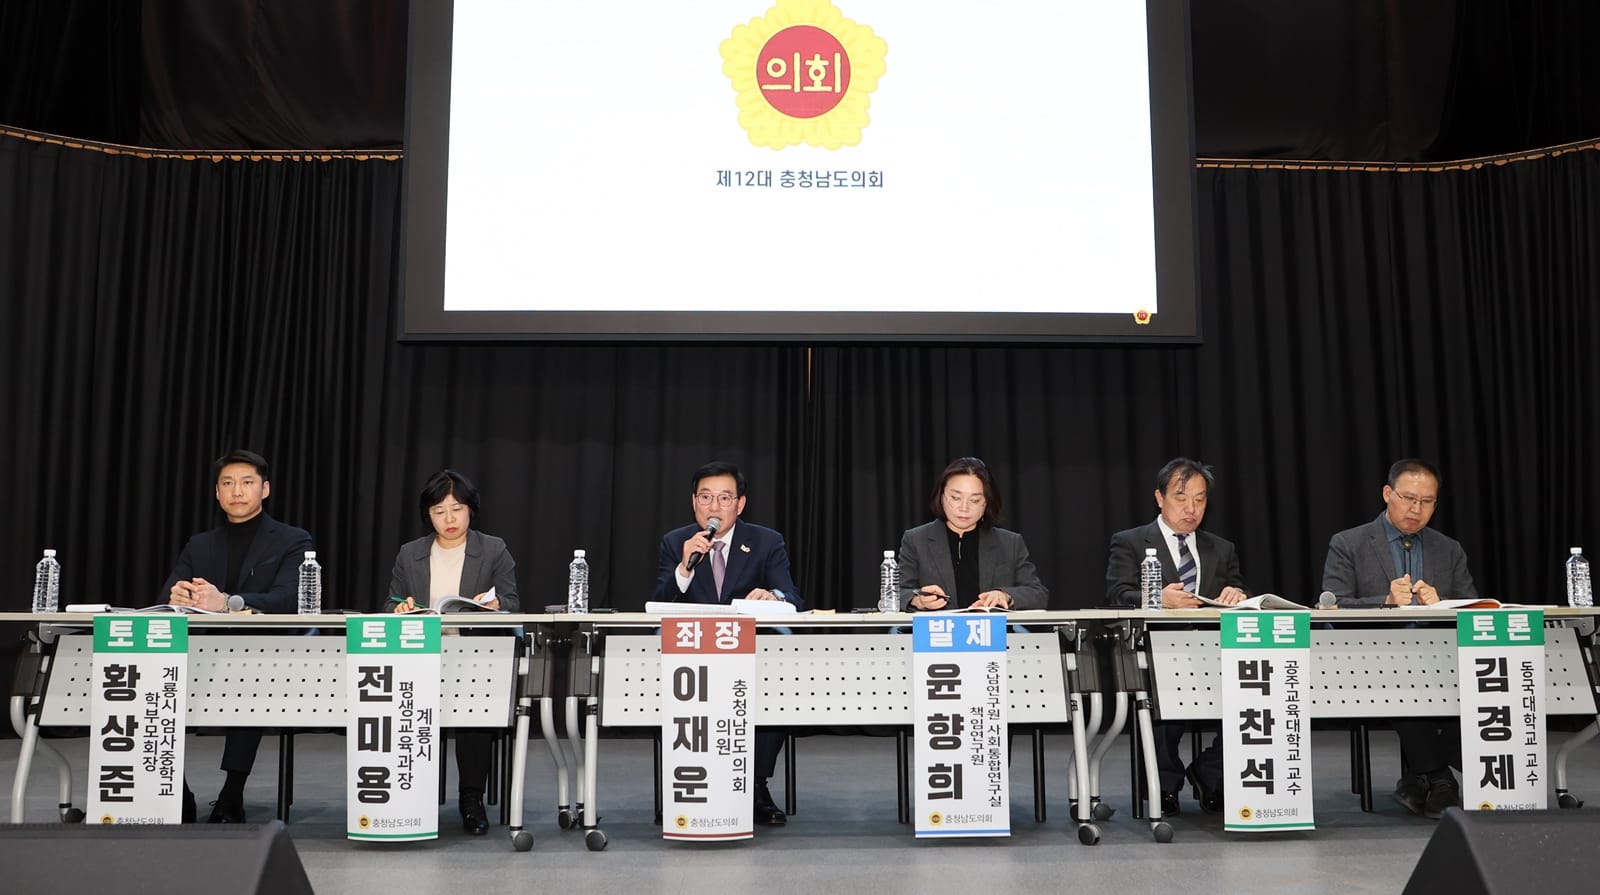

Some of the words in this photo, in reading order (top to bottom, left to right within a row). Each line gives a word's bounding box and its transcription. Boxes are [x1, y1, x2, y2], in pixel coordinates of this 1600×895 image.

[762, 52, 841, 93] 의회
[716, 170, 772, 188] 제12대
[780, 170, 884, 188] 충청남도의회
[161, 667, 178, 714] 계룡시
[986, 662, 1000, 718] 충남연구원
[1284, 661, 1301, 761] 공주교육대학교
[1520, 661, 1537, 746] 동국대학교
[99, 663, 140, 803] 황상준
[142, 692, 159, 772] 학부모회장
[158, 719, 176, 796] 엄사중학교
[357, 665, 392, 804] 전미용
[398, 682, 414, 790] 평생교육과장
[417, 709, 433, 761] 계룡시
[672, 666, 708, 803] 이재운
[716, 719, 731, 755] 의원
[732, 680, 747, 793] 충청남도의회
[926, 663, 965, 800] 윤향희
[970, 707, 984, 765] 책임연구원
[1238, 660, 1275, 794] 박찬석
[1475, 658, 1516, 790] 김경제
[987, 724, 1002, 807] 사회통합연구실
[1287, 767, 1301, 796] 교수
[1526, 755, 1539, 786] 교수
[372, 818, 421, 828] 충청남도의회
[690, 817, 738, 828] 충청남도의회
[945, 814, 992, 824] 충청남도의회
[1255, 808, 1298, 818] 충청남도의회
